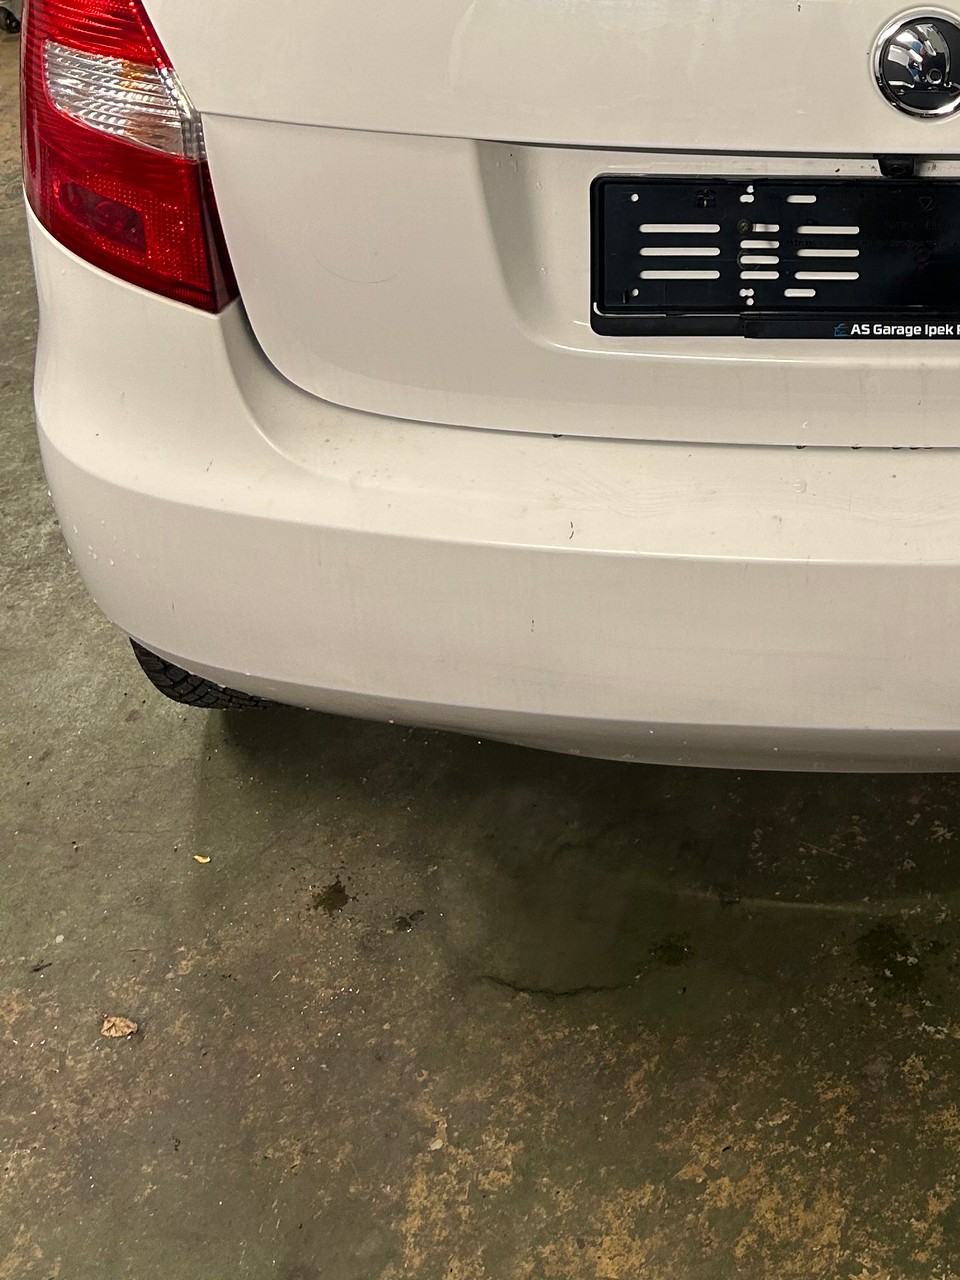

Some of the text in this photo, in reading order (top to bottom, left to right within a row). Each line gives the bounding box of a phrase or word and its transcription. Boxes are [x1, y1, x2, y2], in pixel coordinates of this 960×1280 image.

[850, 323, 871, 335] AS
[873, 323, 922, 337] Garage
[924, 323, 954, 337] Ipek
